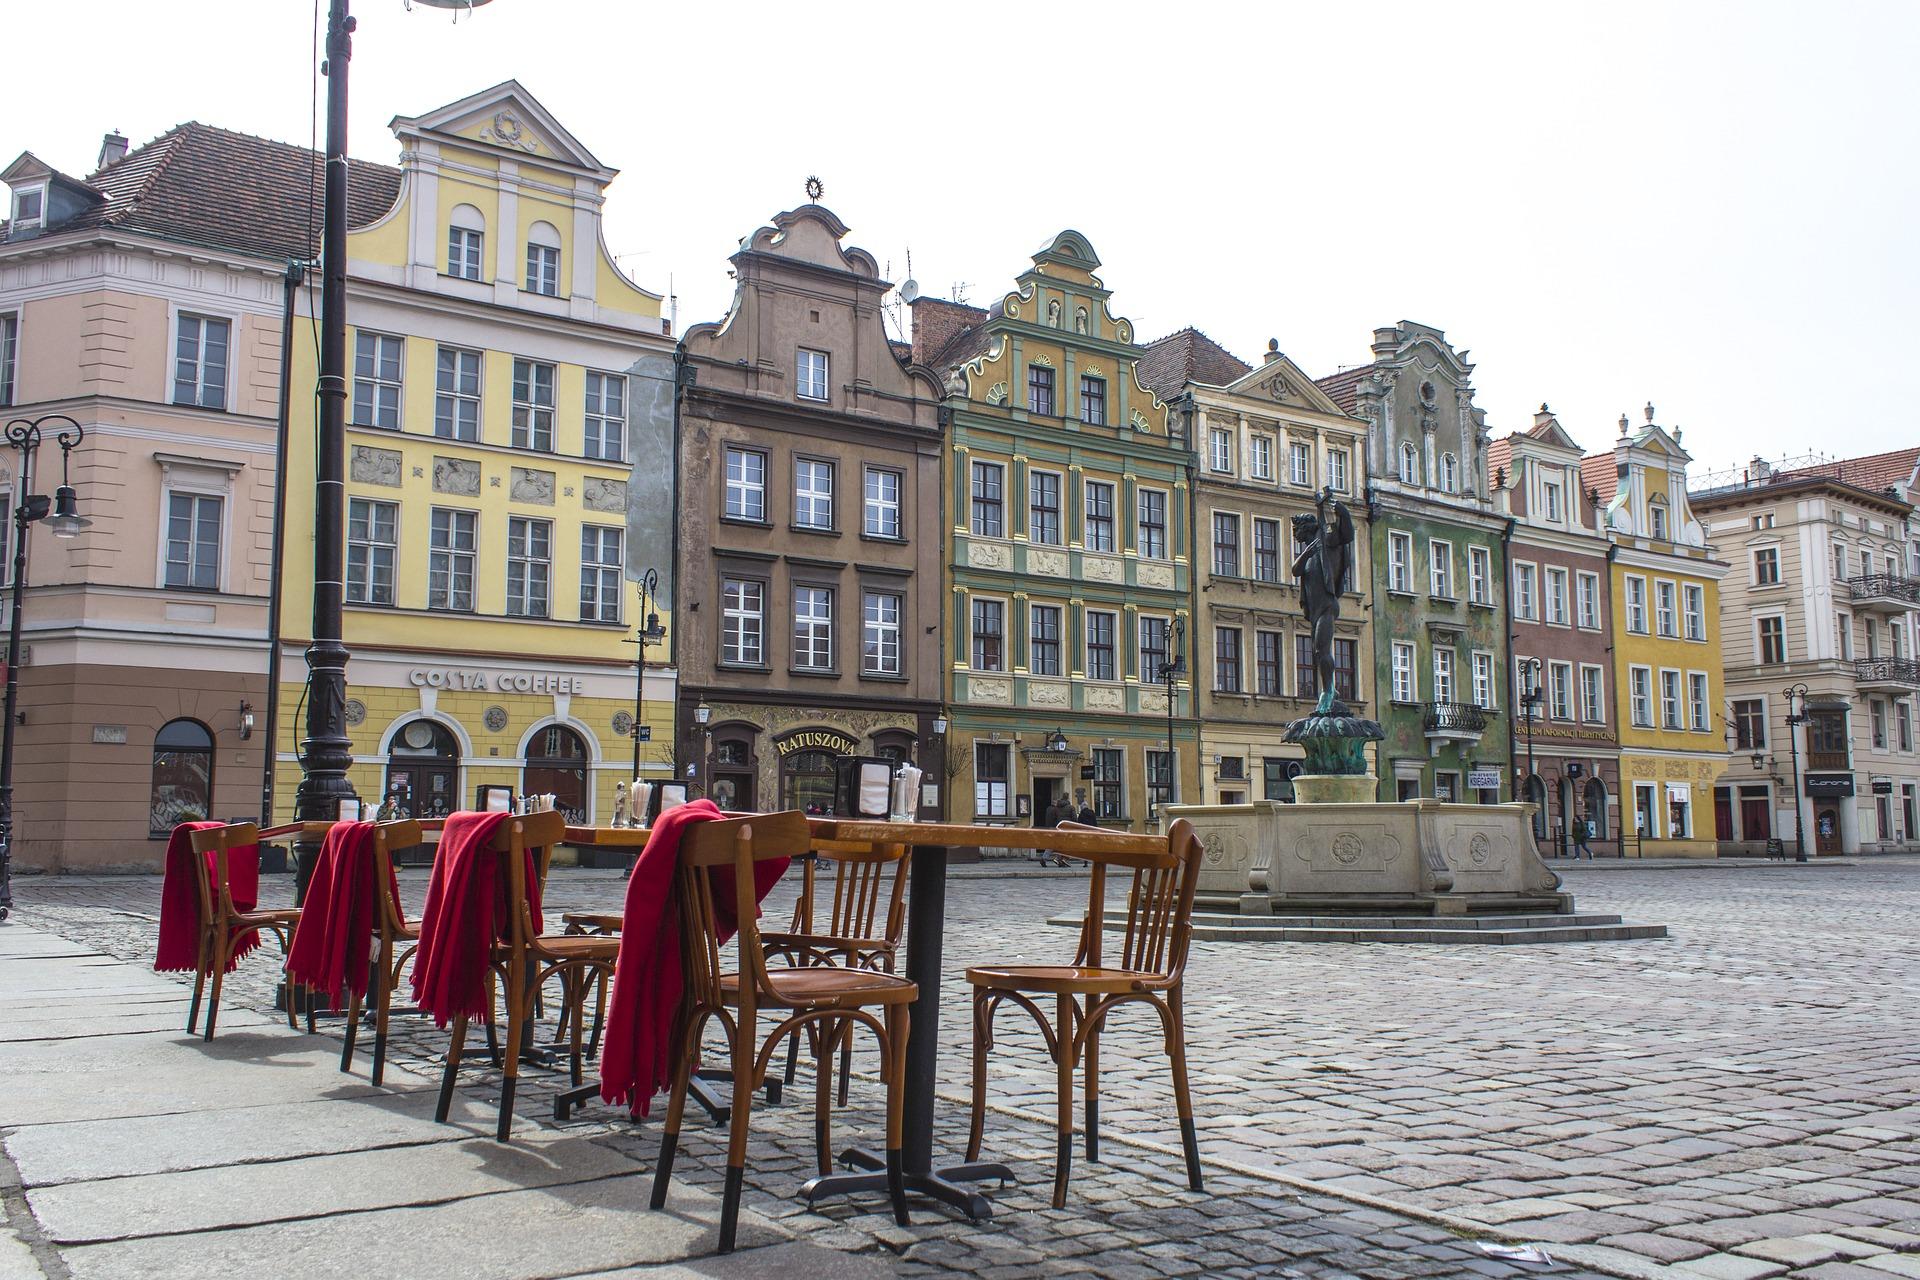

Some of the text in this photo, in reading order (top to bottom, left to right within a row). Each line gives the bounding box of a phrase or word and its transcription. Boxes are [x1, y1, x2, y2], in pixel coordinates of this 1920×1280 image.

[409, 668, 584, 695] COSTA COFFEE
[777, 733, 855, 756] RATUSZOVA
